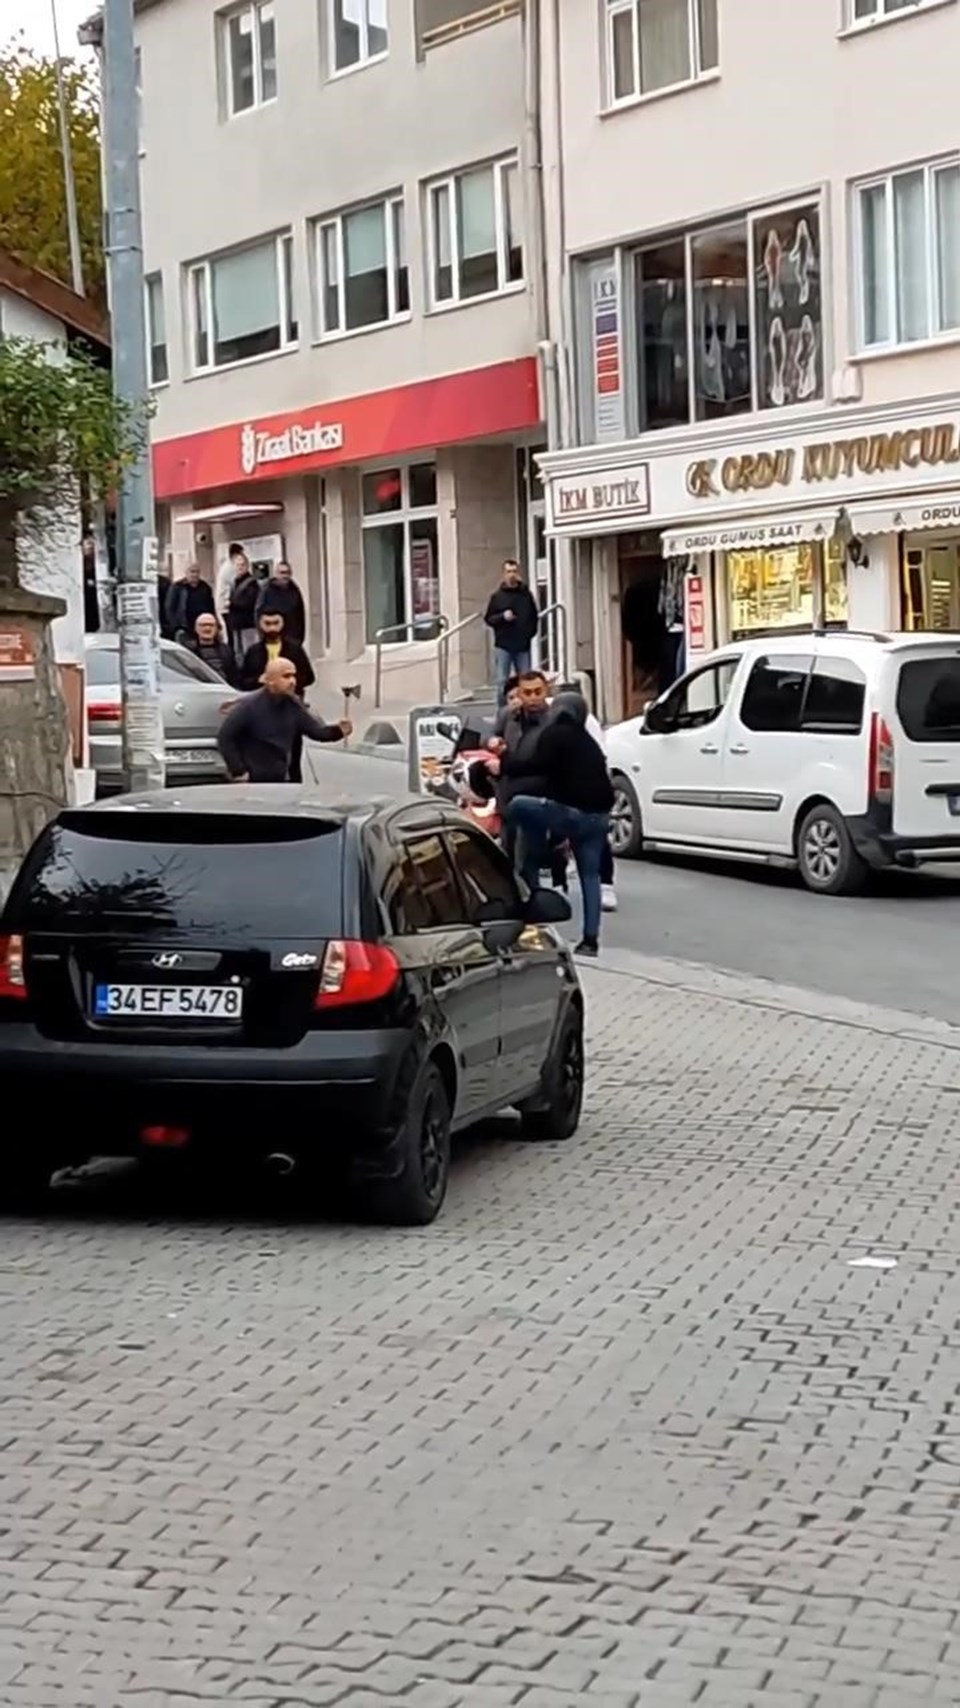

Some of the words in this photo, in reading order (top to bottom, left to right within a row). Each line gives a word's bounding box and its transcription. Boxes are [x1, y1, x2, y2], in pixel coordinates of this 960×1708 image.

[721, 447, 796, 493] ORDU
[801, 423, 960, 484] KUYUMCUL
[592, 478, 641, 508] BUTİK
[921, 505, 960, 521] ORDU
[685, 534, 716, 549] ORDU
[769, 524, 802, 539] SAAT
